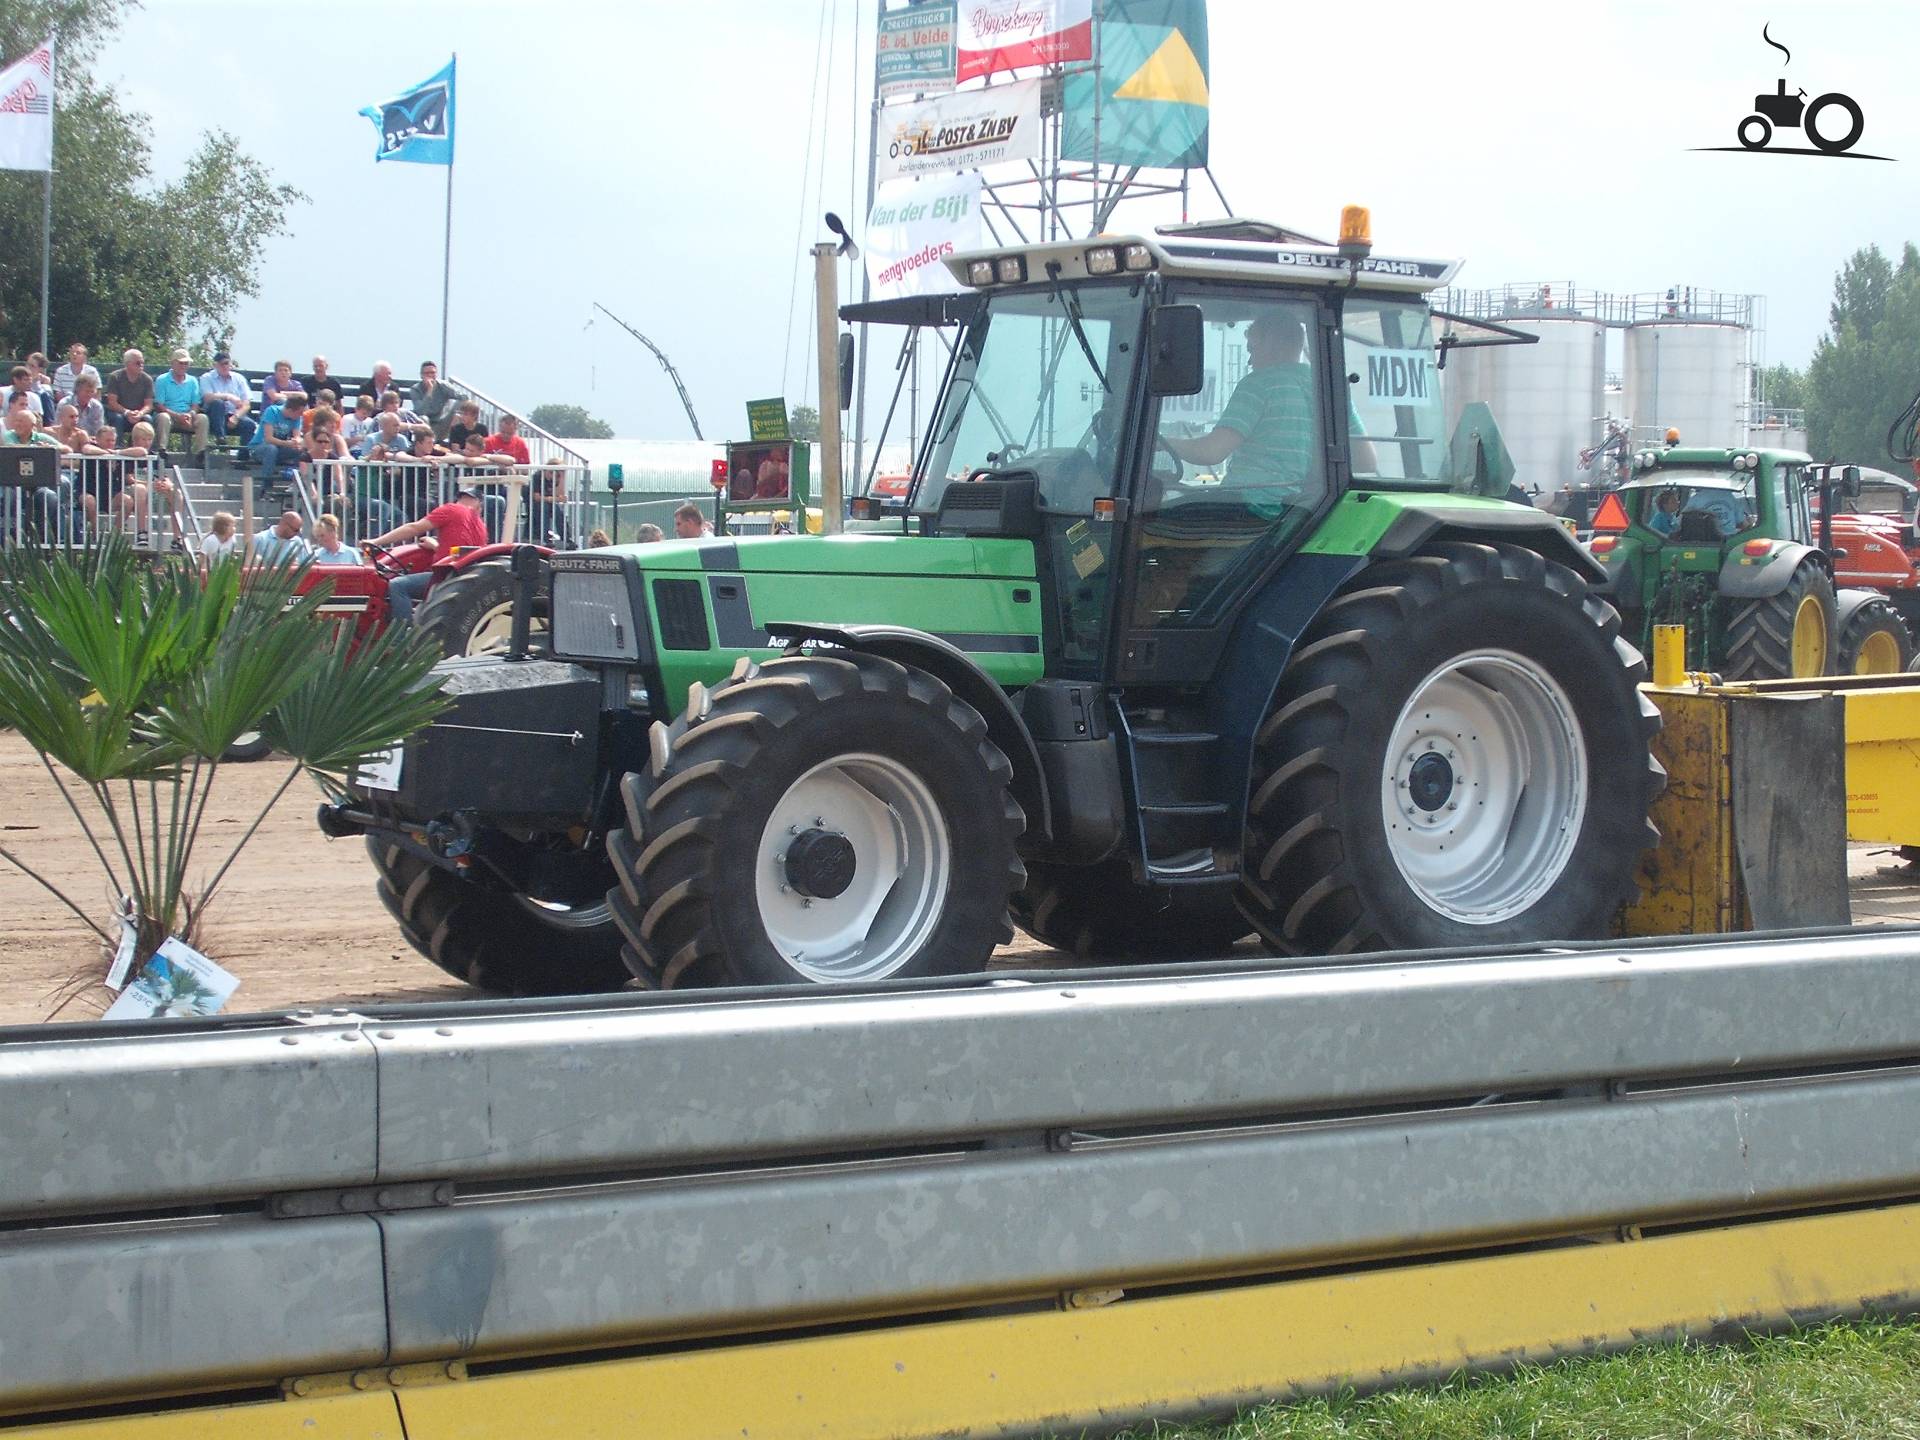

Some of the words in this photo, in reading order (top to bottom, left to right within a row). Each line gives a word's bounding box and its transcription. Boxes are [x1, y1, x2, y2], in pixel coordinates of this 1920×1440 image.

[913, 28, 949, 46] Velde
[936, 127, 968, 147] POST
[966, 124, 976, 141] &
[997, 115, 1018, 136] BV
[871, 205, 897, 227] Van
[899, 201, 928, 222] der
[932, 194, 968, 223] Bijl
[878, 241, 954, 287] mengvoeders
[1368, 355, 1429, 399] MDM
